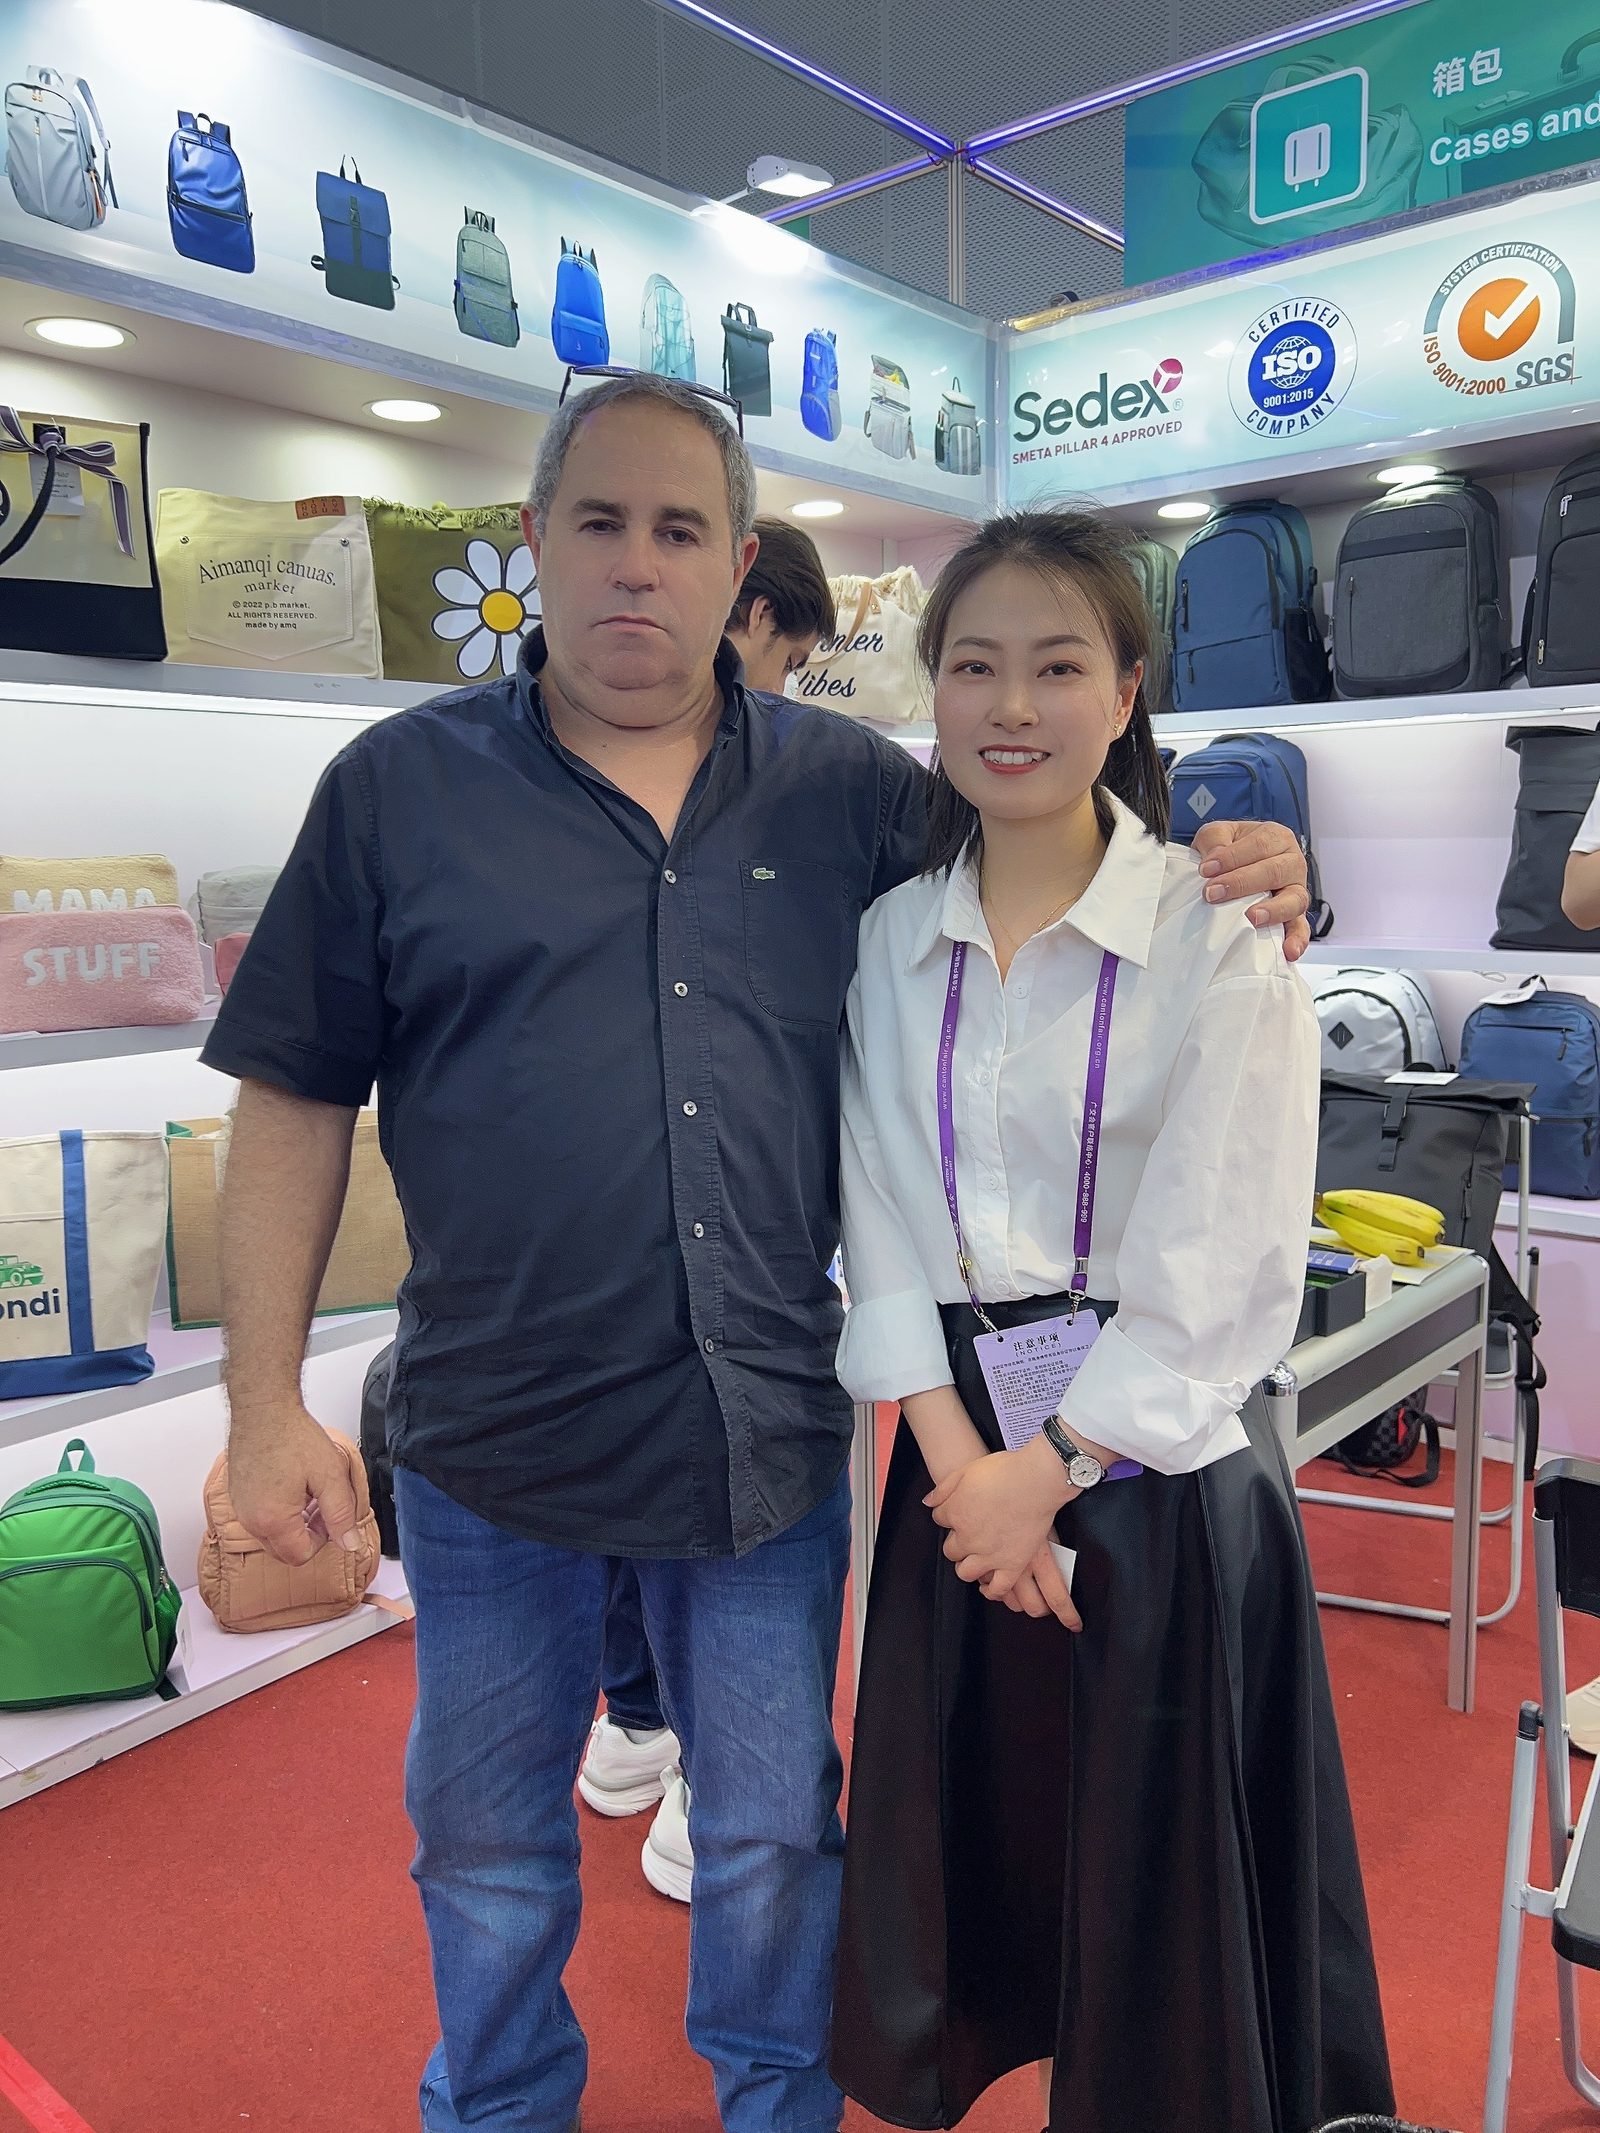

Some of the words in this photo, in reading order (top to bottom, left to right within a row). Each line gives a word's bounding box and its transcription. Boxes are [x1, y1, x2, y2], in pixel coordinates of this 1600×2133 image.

[1432, 48, 1503, 98] 箱包
[1429, 122, 1530, 166] Cases
[1540, 95, 1600, 137] and
[1440, 257, 1480, 296] SYSTEM
[1481, 244, 1563, 274] CERTIFICATION
[1248, 303, 1340, 343] CERTIFIED
[1262, 345, 1322, 380] ISO
[1424, 336, 1441, 364] ISO
[1433, 363, 1506, 395] 9001:2000
[1515, 353, 1573, 388] SGS
[1013, 371, 1174, 443] Sedex
[1247, 393, 1335, 435] COMPANY
[1263, 388, 1314, 408] 9001:2015
[1012, 447, 1052, 465] SMETA
[1055, 438, 1098, 457] PILLAR
[1100, 435, 1109, 447] 4
[1112, 420, 1183, 445] APPROVED
[199, 554, 273, 585] Aimanqi
[244, 579, 296, 595] market
[227, 611, 242, 619] ALL
[243, 611, 272, 619] RIGHTS
[273, 611, 318, 620] RESERVED.
[269, 622, 279, 630] by
[23, 942, 162, 986] STUFF
[1095, 976, 1110, 1069] www.cantonfair.org.cn
[942, 1024, 953, 1110] www.cantonfair.org.cn
[0, 1288, 61, 1320] ndi
[1013, 1331, 1060, 1352] 注意事项
